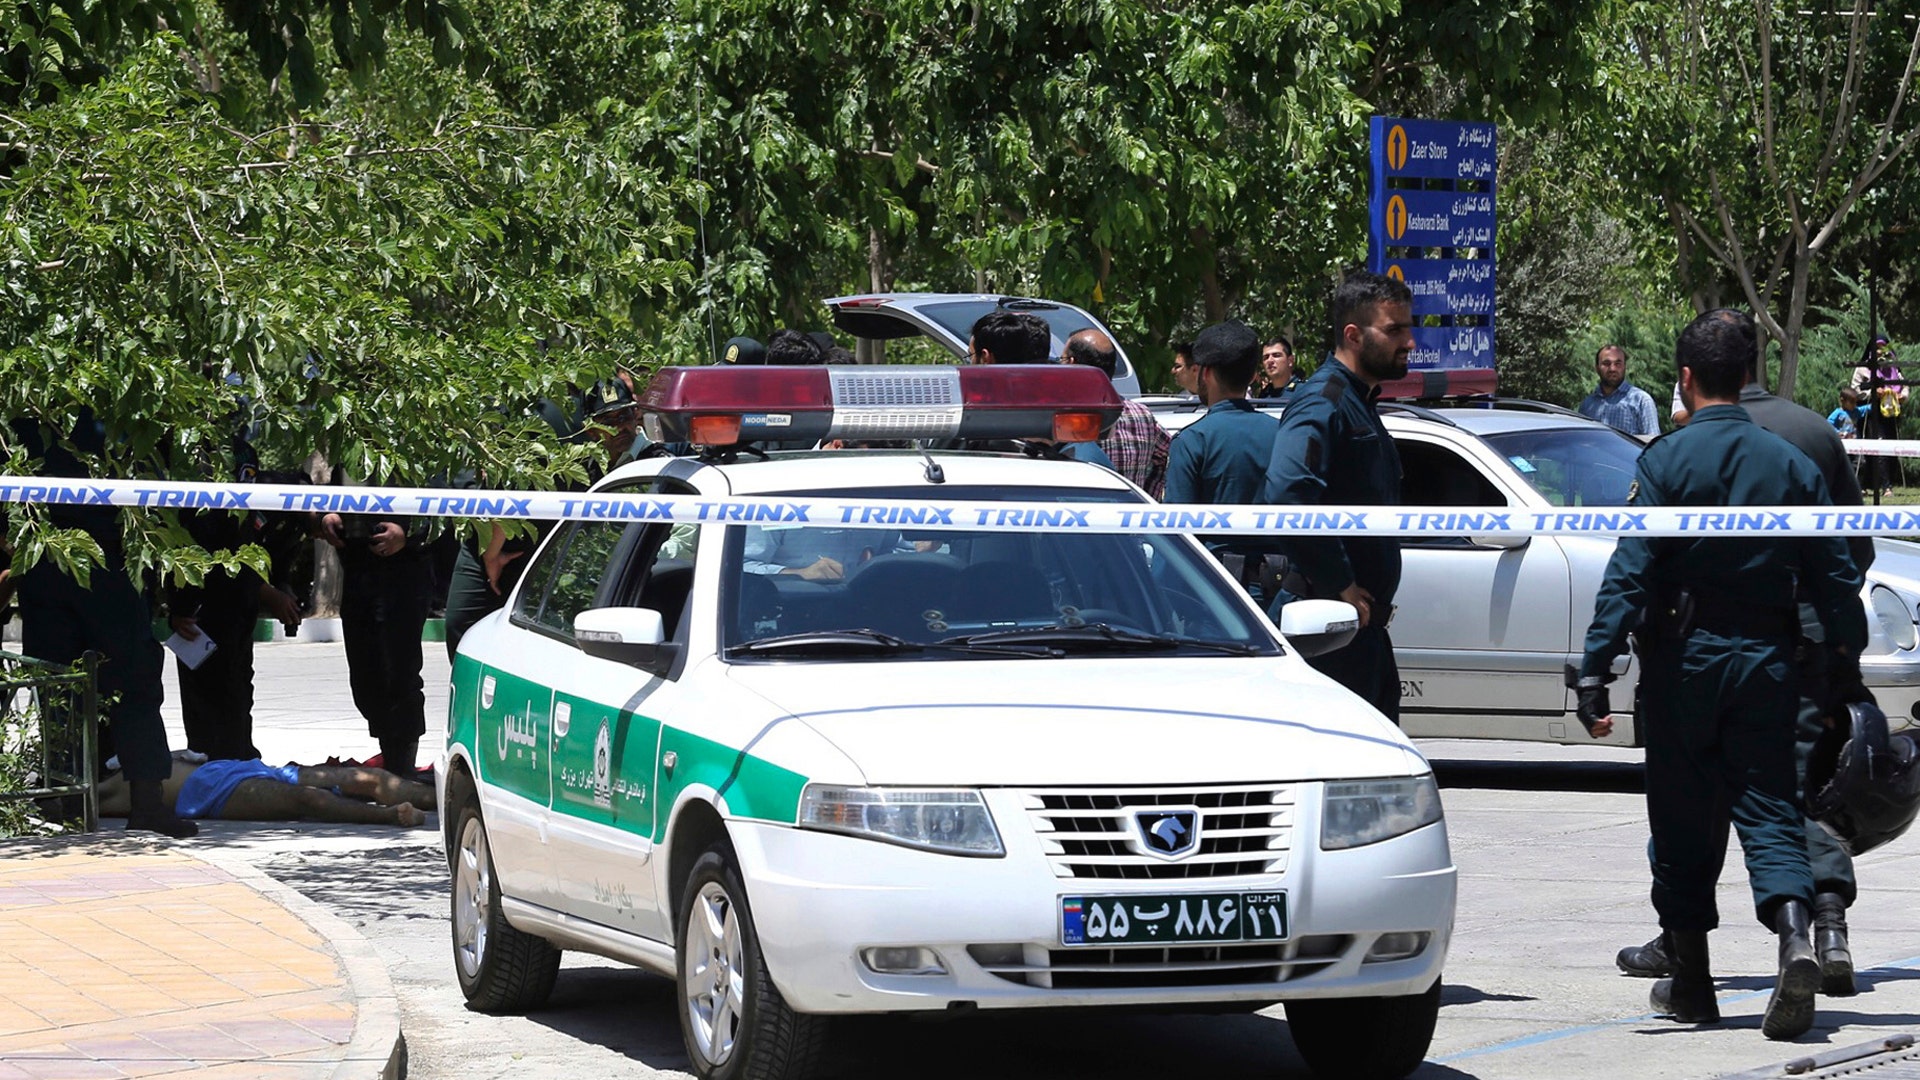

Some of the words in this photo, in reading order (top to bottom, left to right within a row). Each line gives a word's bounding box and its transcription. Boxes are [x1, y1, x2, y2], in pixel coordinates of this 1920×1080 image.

[1411, 141, 1428, 159] Zaer
[1428, 141, 1448, 159] Store
[1436, 213, 1449, 231] Bank
[1424, 348, 1441, 364] Hotel
[0, 485, 115, 505] TRINX
[134, 485, 252, 509] TRINX
[279, 489, 396, 513] TRINX
[415, 494, 531, 517] TRINX
[559, 498, 675, 520] TRINX
[695, 503, 811, 522] TRINX
[839, 504, 954, 525] TRINX
[974, 507, 1089, 527] TRINX
[1117, 509, 1232, 529] TRINX
[1252, 510, 1368, 530] TRINX
[1395, 510, 1511, 531] TRINX
[1531, 511, 1648, 531] TRINX
[1675, 511, 1792, 532] TRINX
[1811, 510, 1920, 531] TRINX
[498, 700, 537, 770] پلیس
[578, 769, 594, 789] تهران
[1246, 894, 1280, 903] ایران
